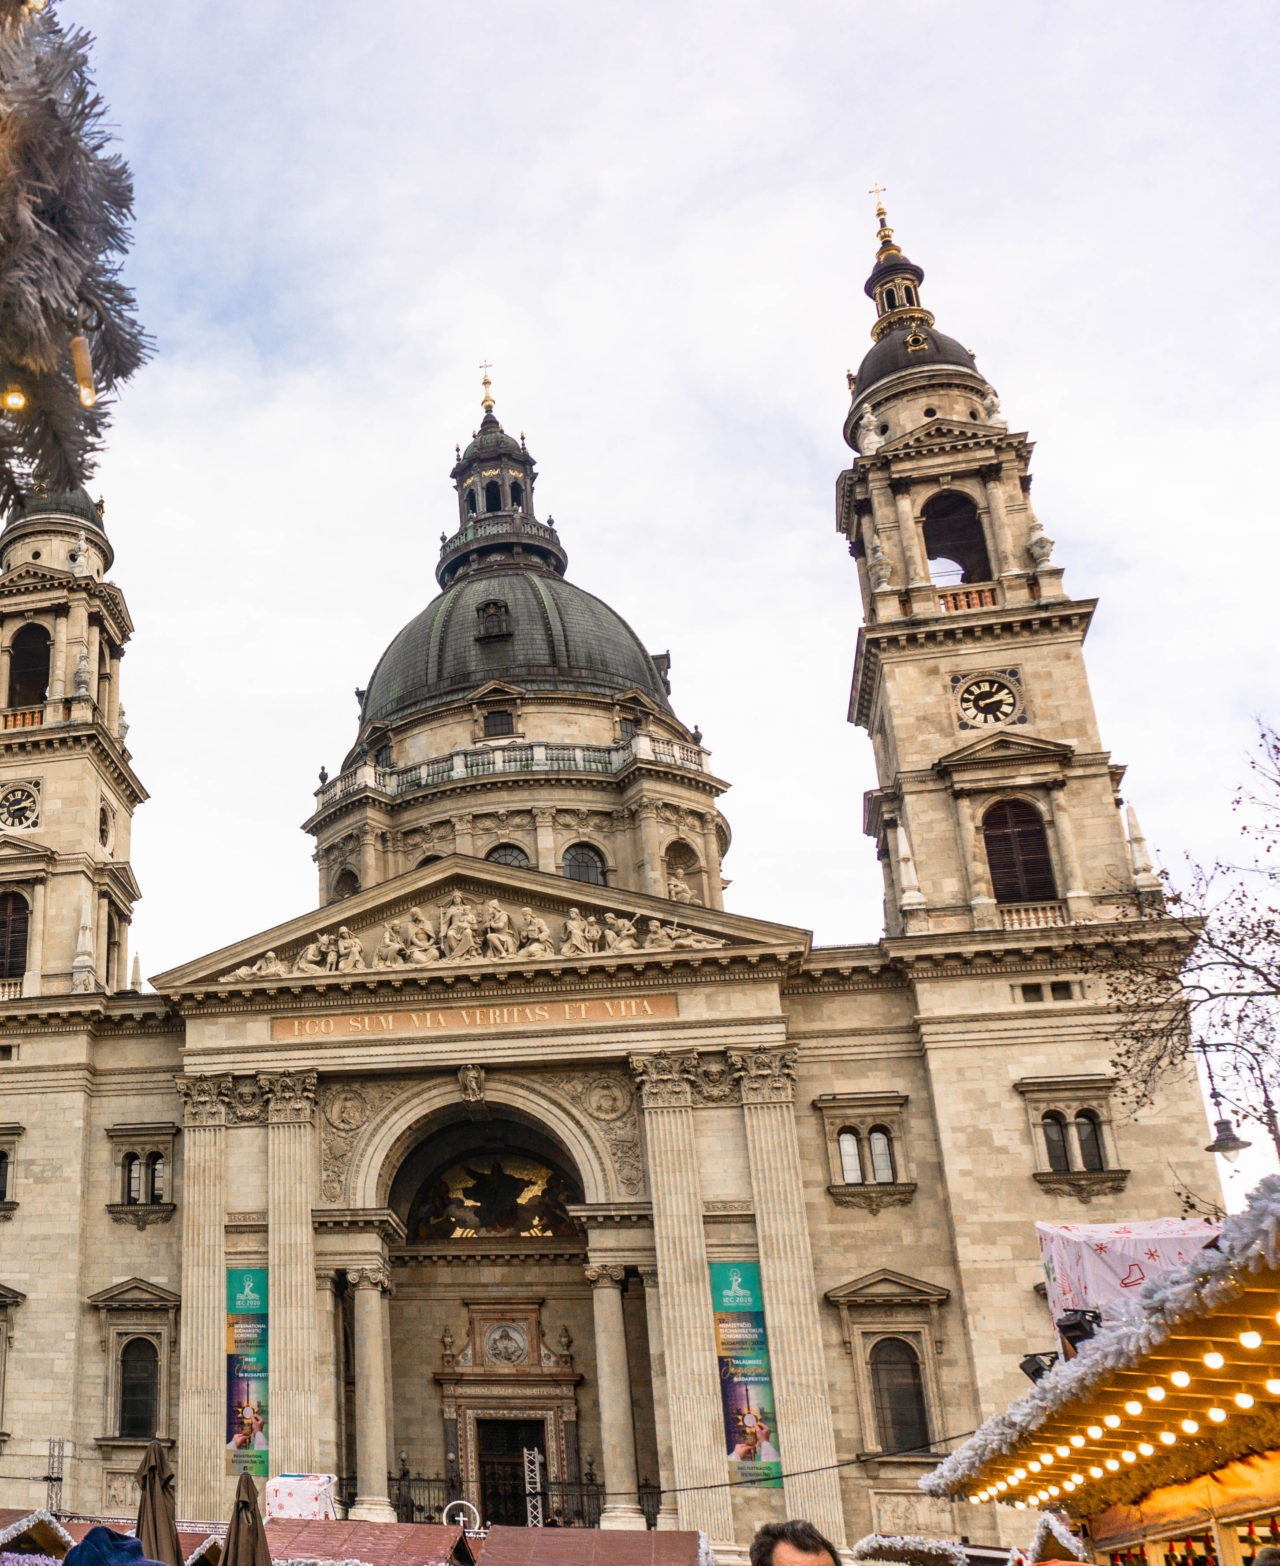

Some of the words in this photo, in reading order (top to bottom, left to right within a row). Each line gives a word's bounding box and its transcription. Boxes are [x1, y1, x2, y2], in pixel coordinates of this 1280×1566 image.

[292, 1019, 334, 1036] EGO
[349, 1014, 394, 1032] SUM
[410, 1011, 447, 1028] VIA
[460, 1006, 550, 1025] VERITAS
[563, 1003, 589, 1020] ET
[604, 999, 654, 1017] VITA
